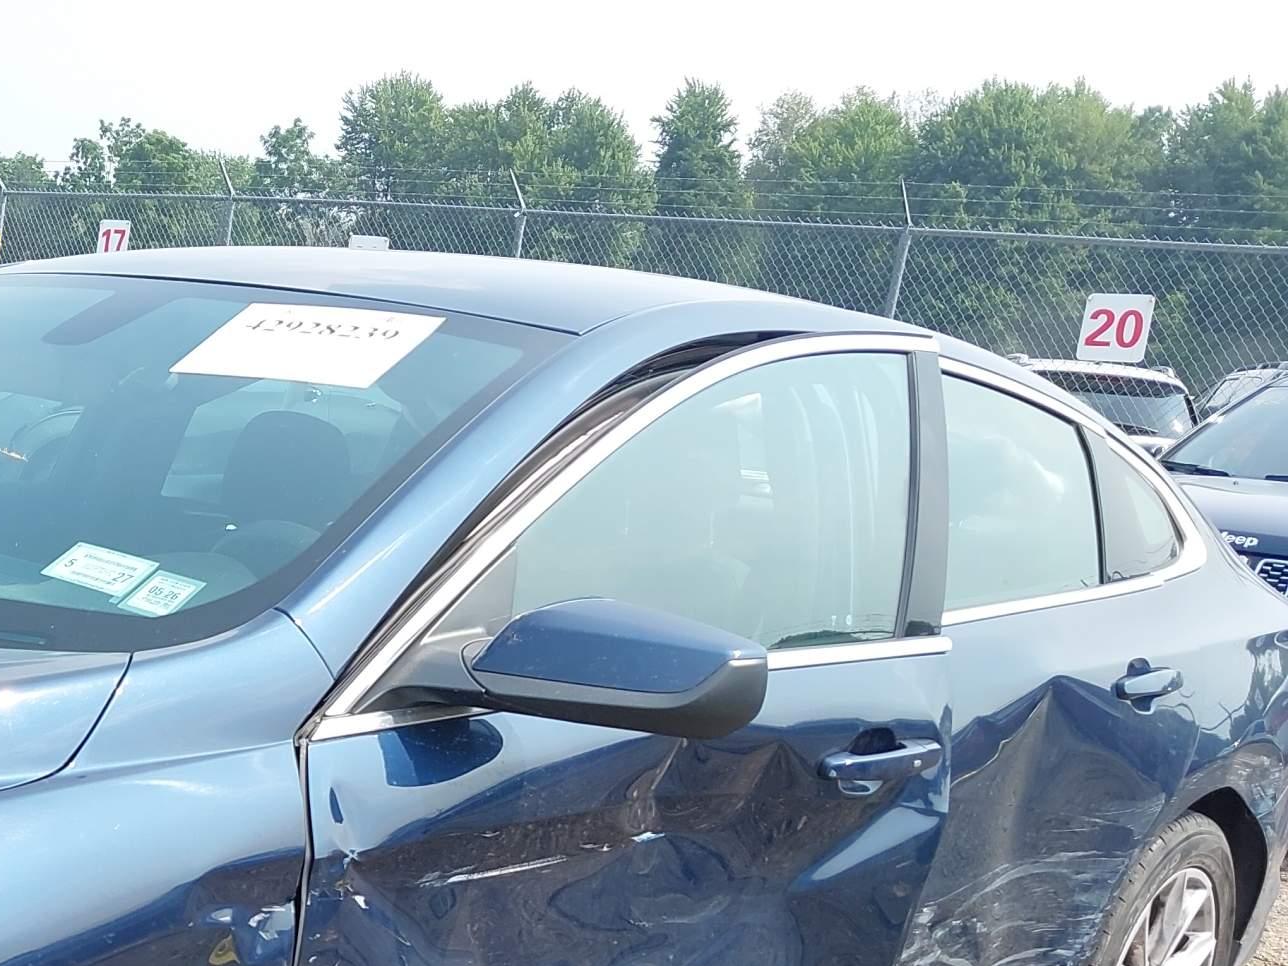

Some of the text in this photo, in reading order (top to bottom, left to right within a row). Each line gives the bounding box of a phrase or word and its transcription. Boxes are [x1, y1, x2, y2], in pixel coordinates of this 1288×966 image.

[102, 228, 126, 253] 17
[245, 319, 400, 341] 42928239
[1084, 308, 1144, 349] 20
[111, 572, 135, 584] 27
